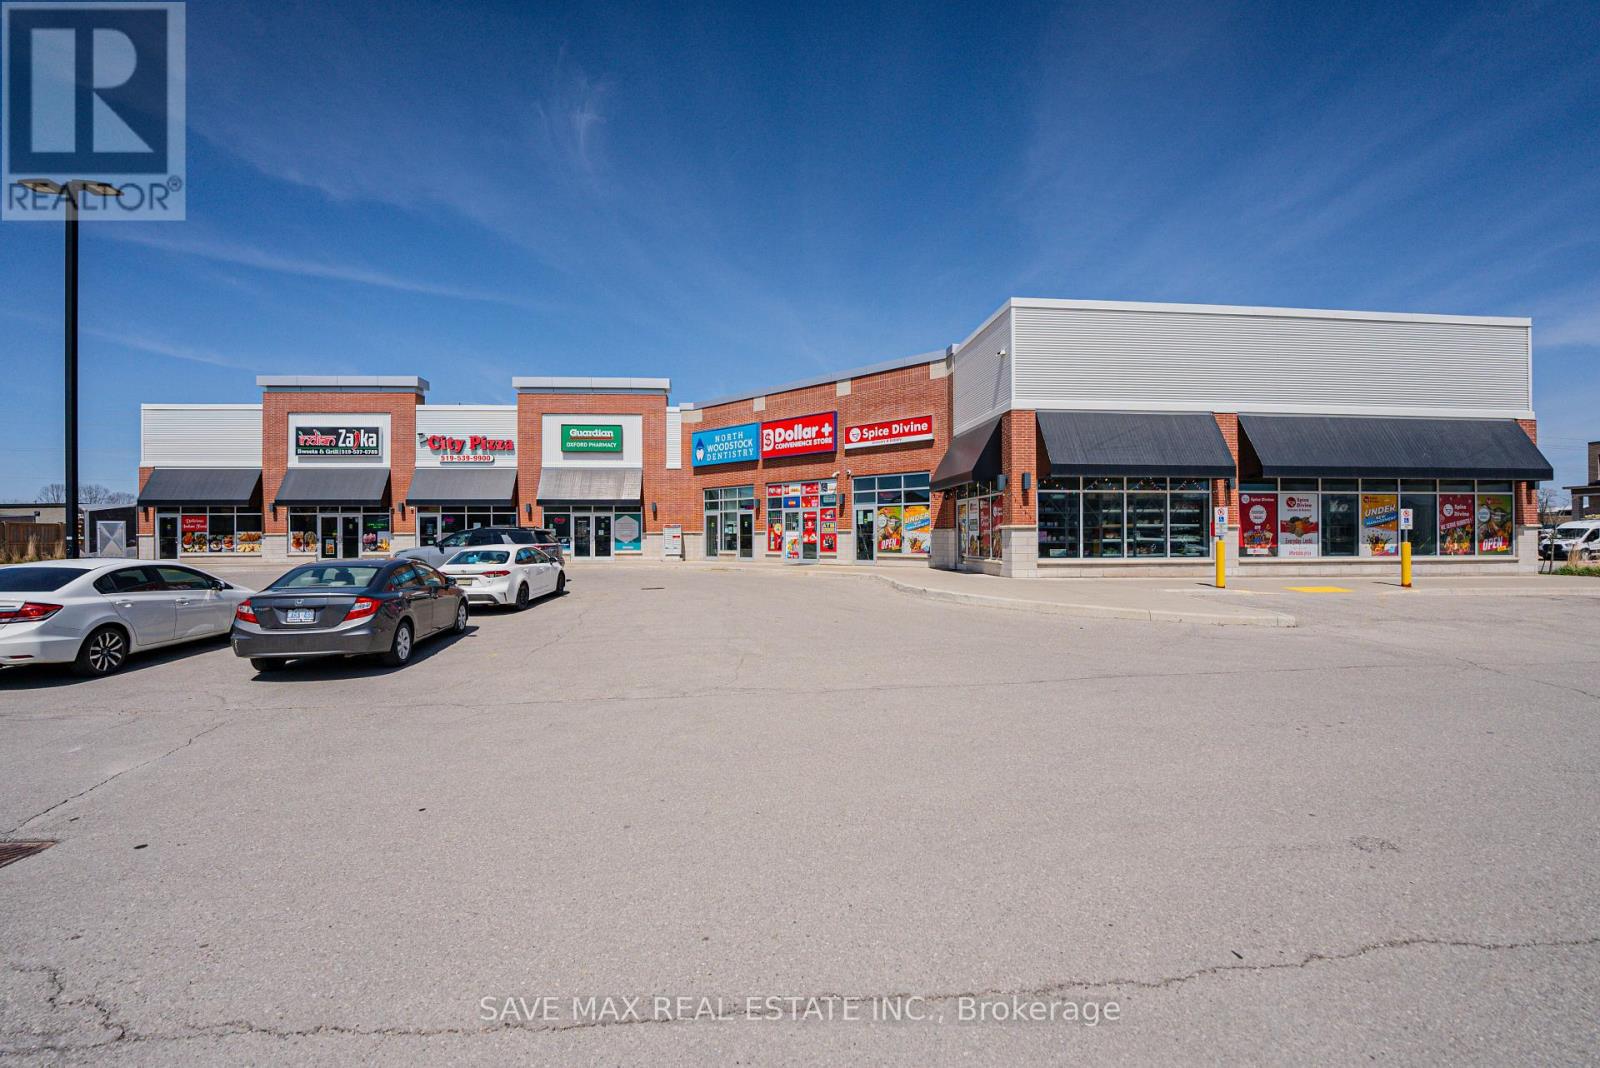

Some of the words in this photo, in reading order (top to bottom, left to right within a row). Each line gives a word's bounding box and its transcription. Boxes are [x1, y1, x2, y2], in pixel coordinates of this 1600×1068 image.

[570, 428, 614, 437] Guardian
[715, 432, 743, 441] NORTH
[775, 424, 819, 442] Dollar
[862, 427, 889, 440] Spice
[892, 422, 928, 434] Divine
[428, 435, 465, 453] City
[469, 435, 515, 451] Pizza
[707, 438, 753, 452] WOODSTOCK
[775, 439, 812, 449] CONVENIENCE
[813, 437, 832, 445] STORE
[707, 448, 754, 461] DENTISTRY
[1365, 504, 1396, 517] UNDER
[905, 512, 929, 523] UNDER
[881, 538, 897, 550] OPEN
[1482, 536, 1503, 551] OPEN
